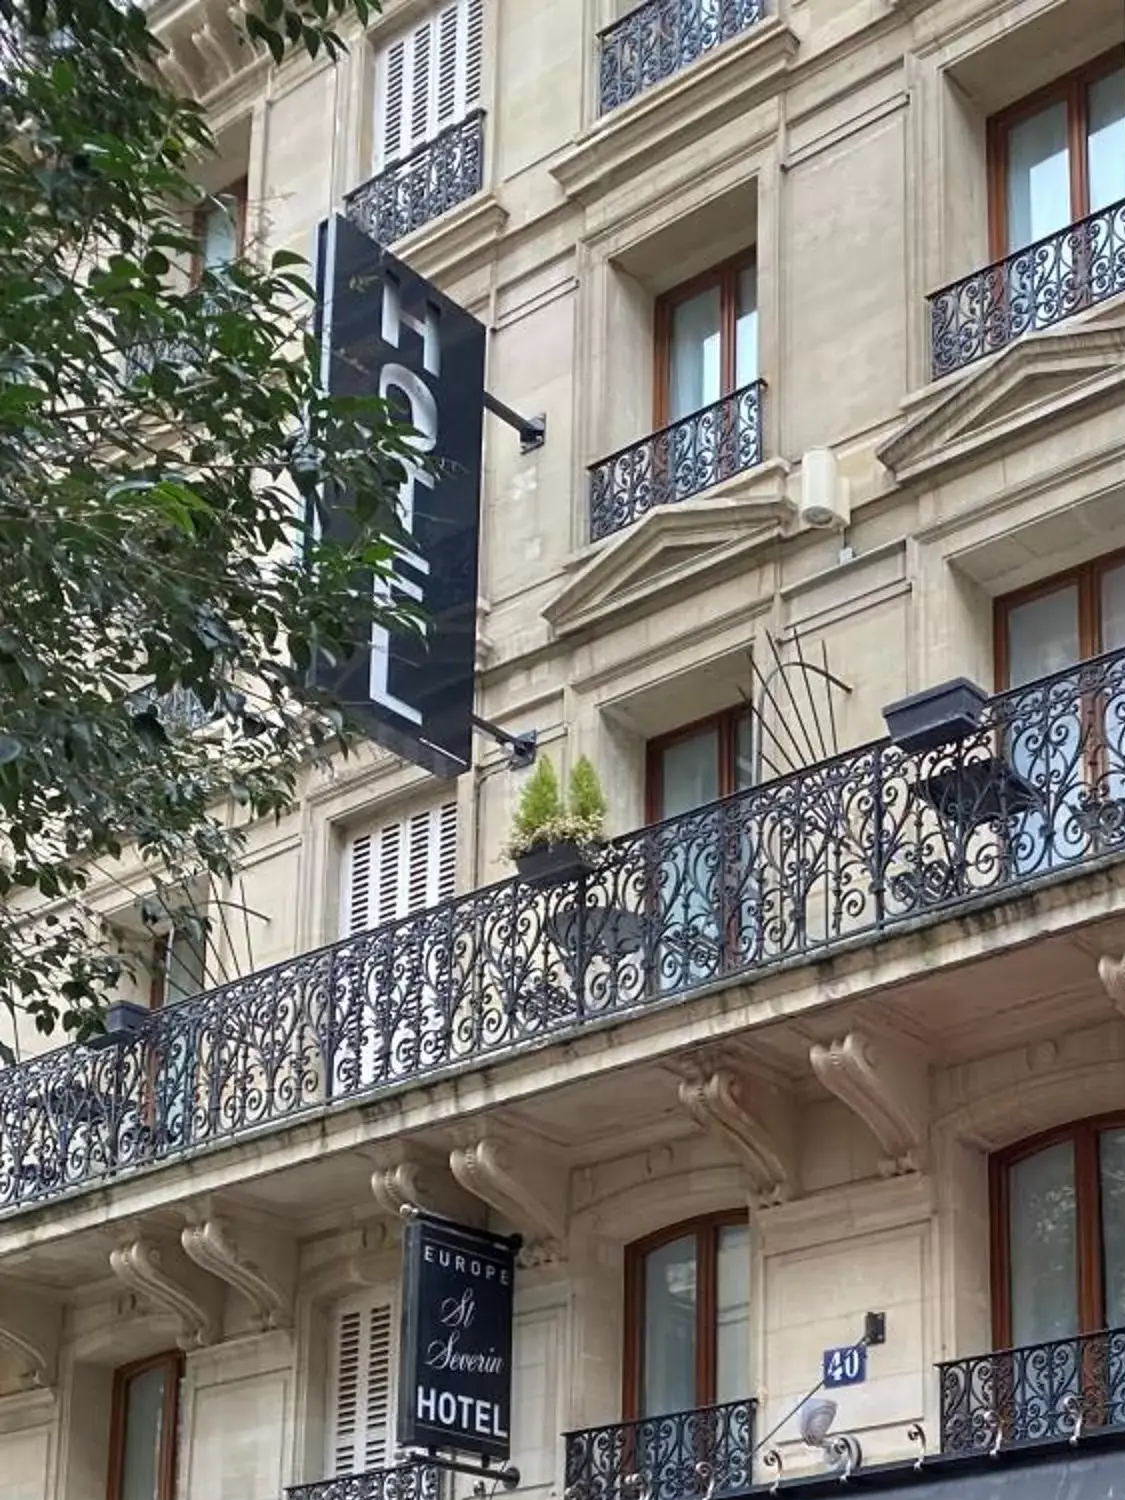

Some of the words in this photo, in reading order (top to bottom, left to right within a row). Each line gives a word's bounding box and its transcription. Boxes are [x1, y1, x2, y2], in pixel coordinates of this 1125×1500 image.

[424, 1245, 510, 1286] EUROPE
[440, 1287, 476, 1329] St
[424, 1331, 504, 1375] Severin
[827, 1348, 859, 1381] 40
[416, 1384, 509, 1438] HOTEL
